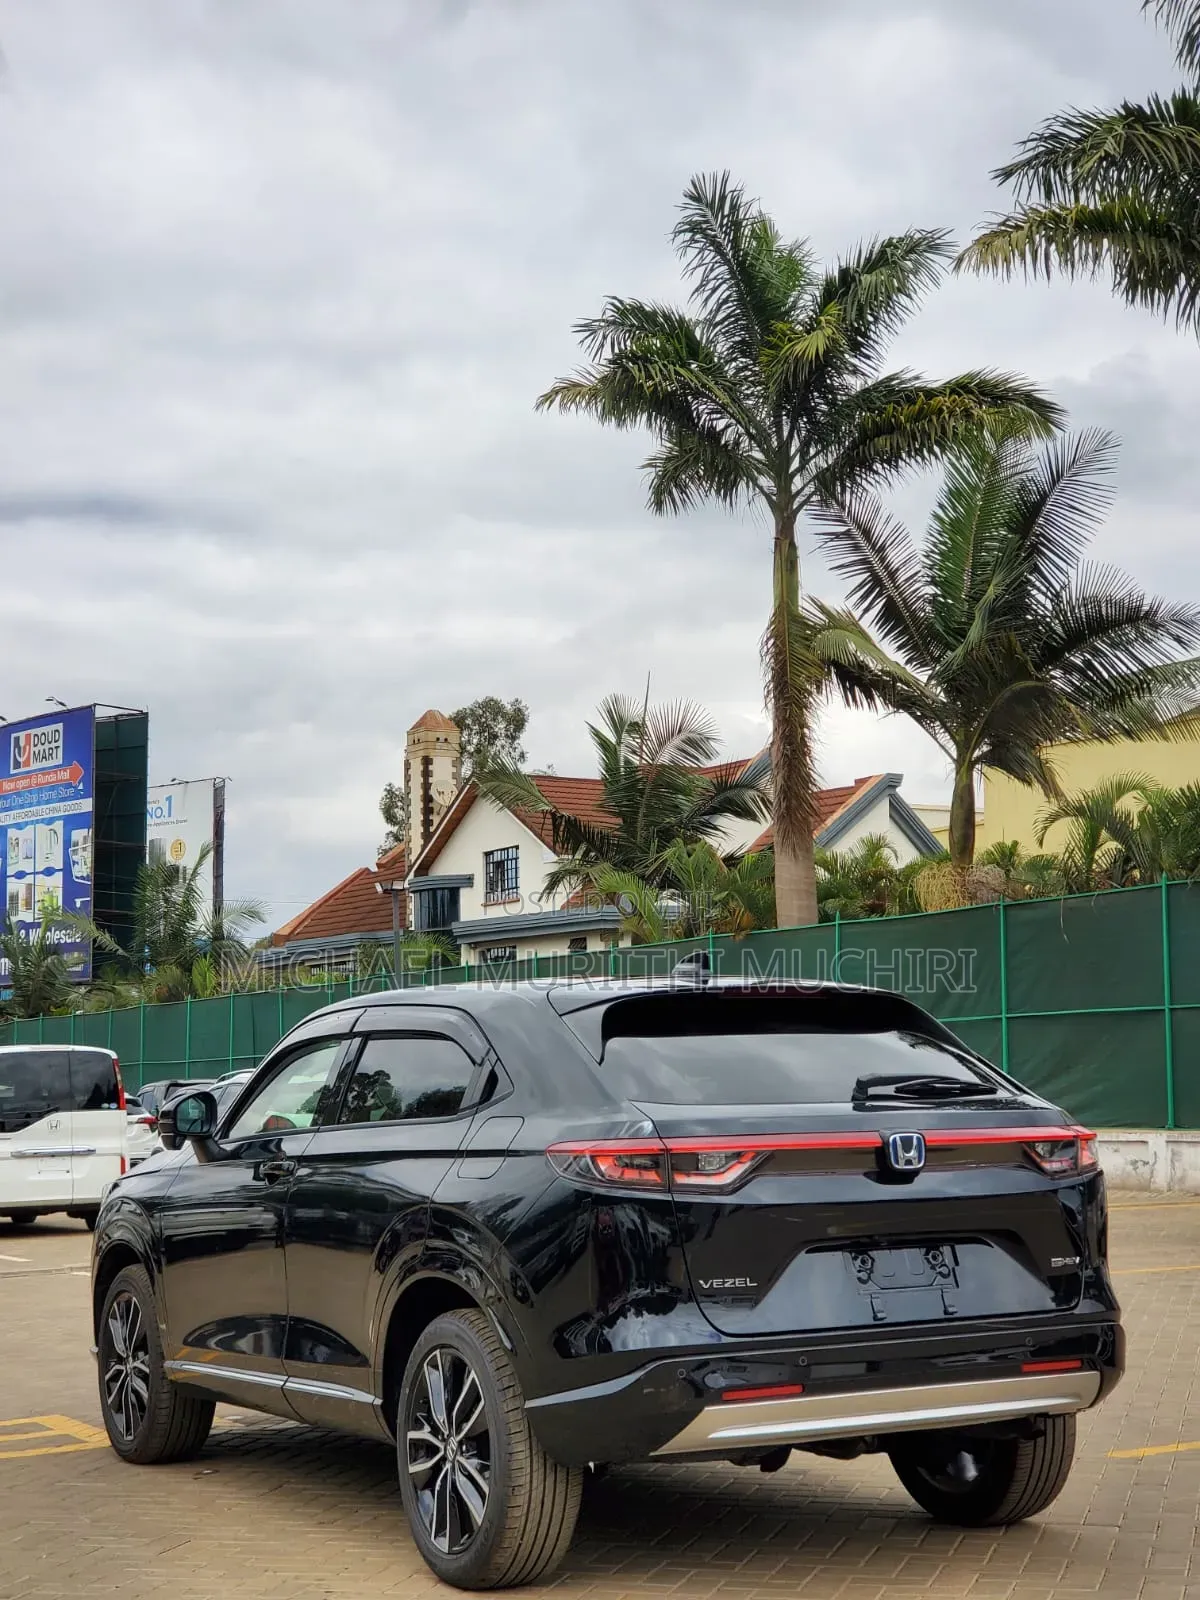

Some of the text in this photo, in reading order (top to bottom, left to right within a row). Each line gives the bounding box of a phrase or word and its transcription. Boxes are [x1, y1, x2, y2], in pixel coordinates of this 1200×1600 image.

[33, 729, 60, 748] DOUD
[33, 745, 60, 764] MART
[3, 770, 70, 792] Now open @ Runda Mall
[40, 789, 57, 801] Home
[58, 787, 75, 798] Store
[12, 808, 45, 820] AFFORDABLE
[45, 805, 61, 816] CHINA
[63, 802, 83, 813] GOODS
[698, 1277, 758, 1289] VEZEL
